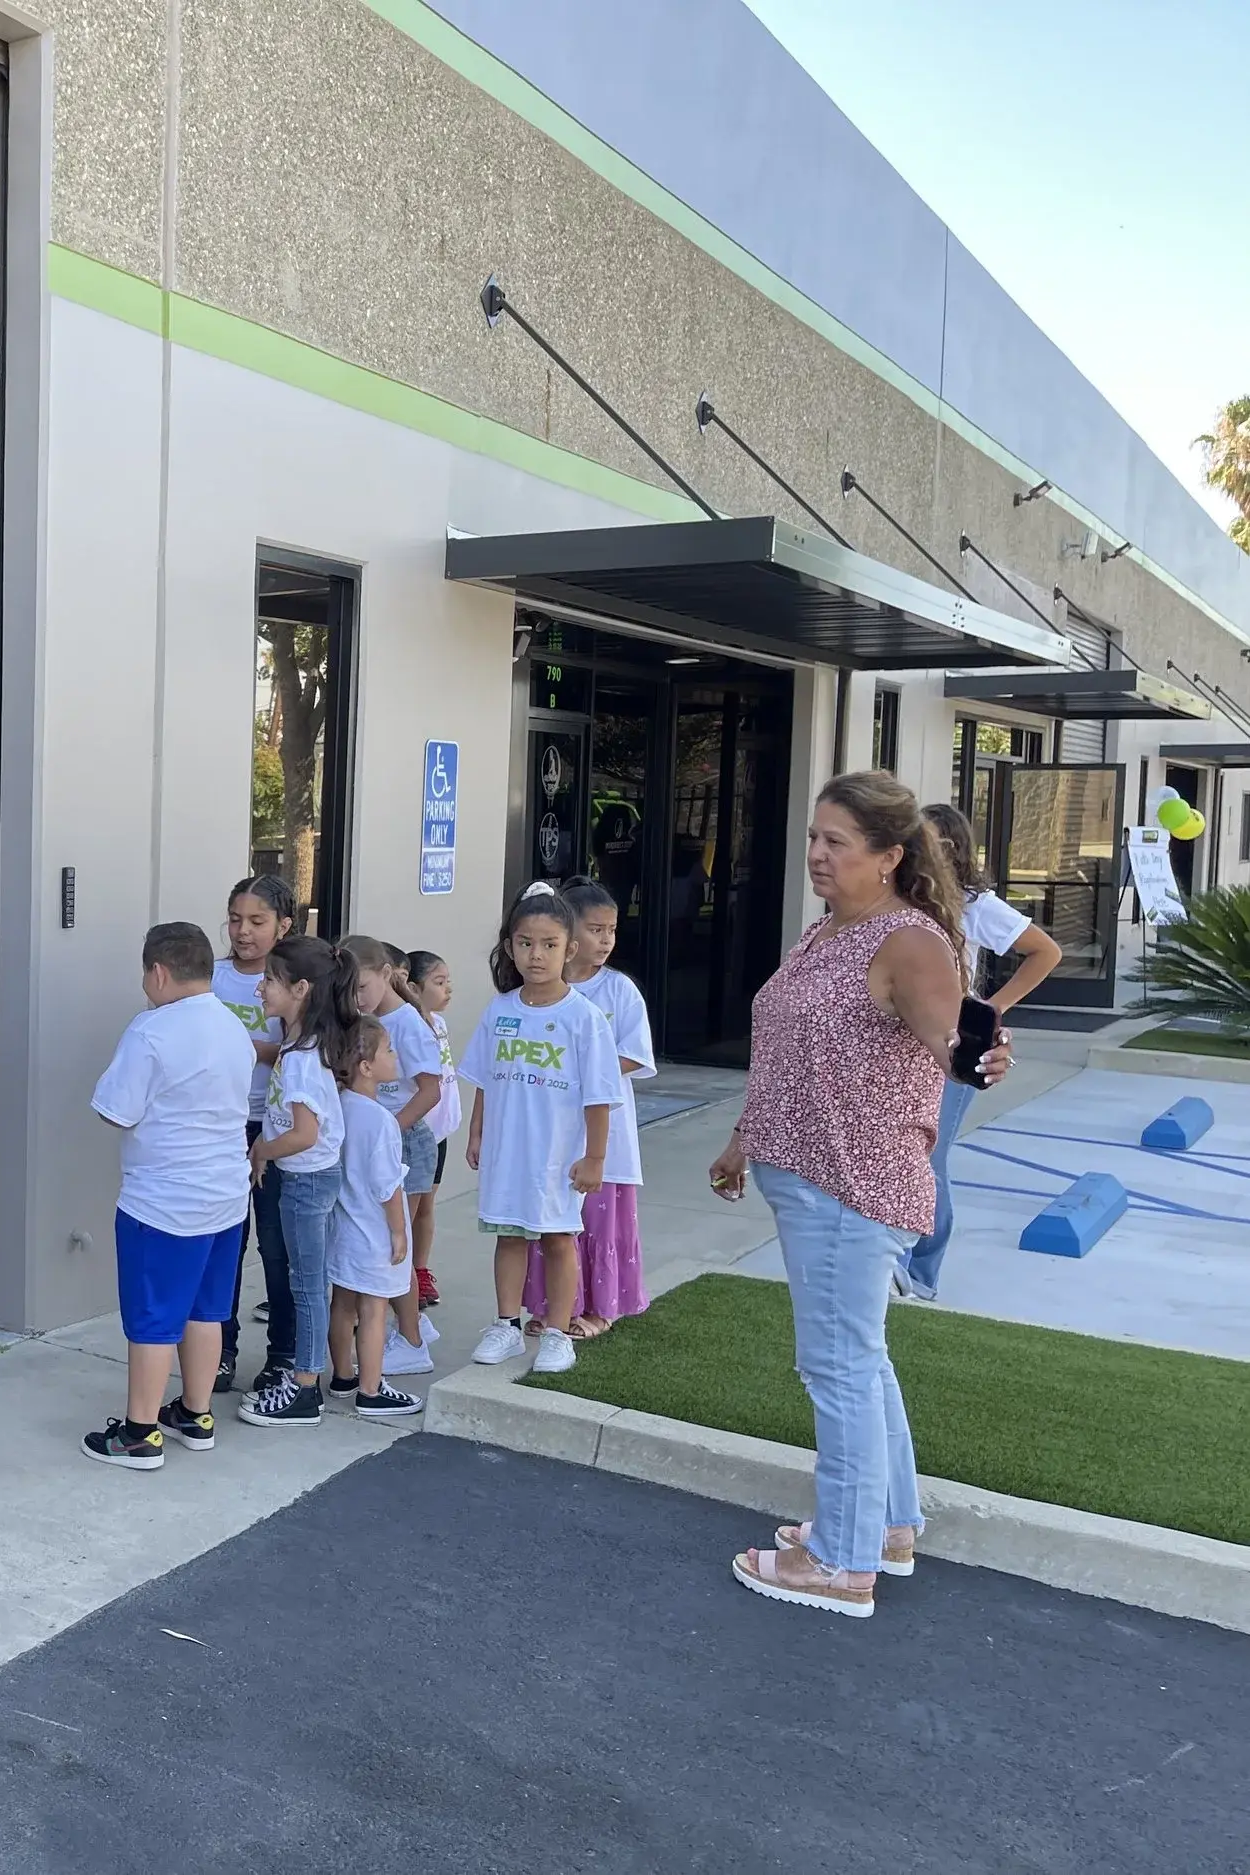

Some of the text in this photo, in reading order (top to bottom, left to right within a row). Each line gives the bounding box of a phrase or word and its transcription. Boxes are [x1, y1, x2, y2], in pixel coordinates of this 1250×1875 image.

[546, 665, 562, 682] 790
[550, 693, 556, 708] B
[425, 800, 455, 822] PARKING
[430, 824, 449, 845] ONLY
[222, 1000, 270, 1033] EX
[495, 1039, 567, 1070] APEX
[527, 1073, 546, 1086] Day
[547, 1079, 569, 1090] 2022
[271, 1116, 292, 1129] 2022
